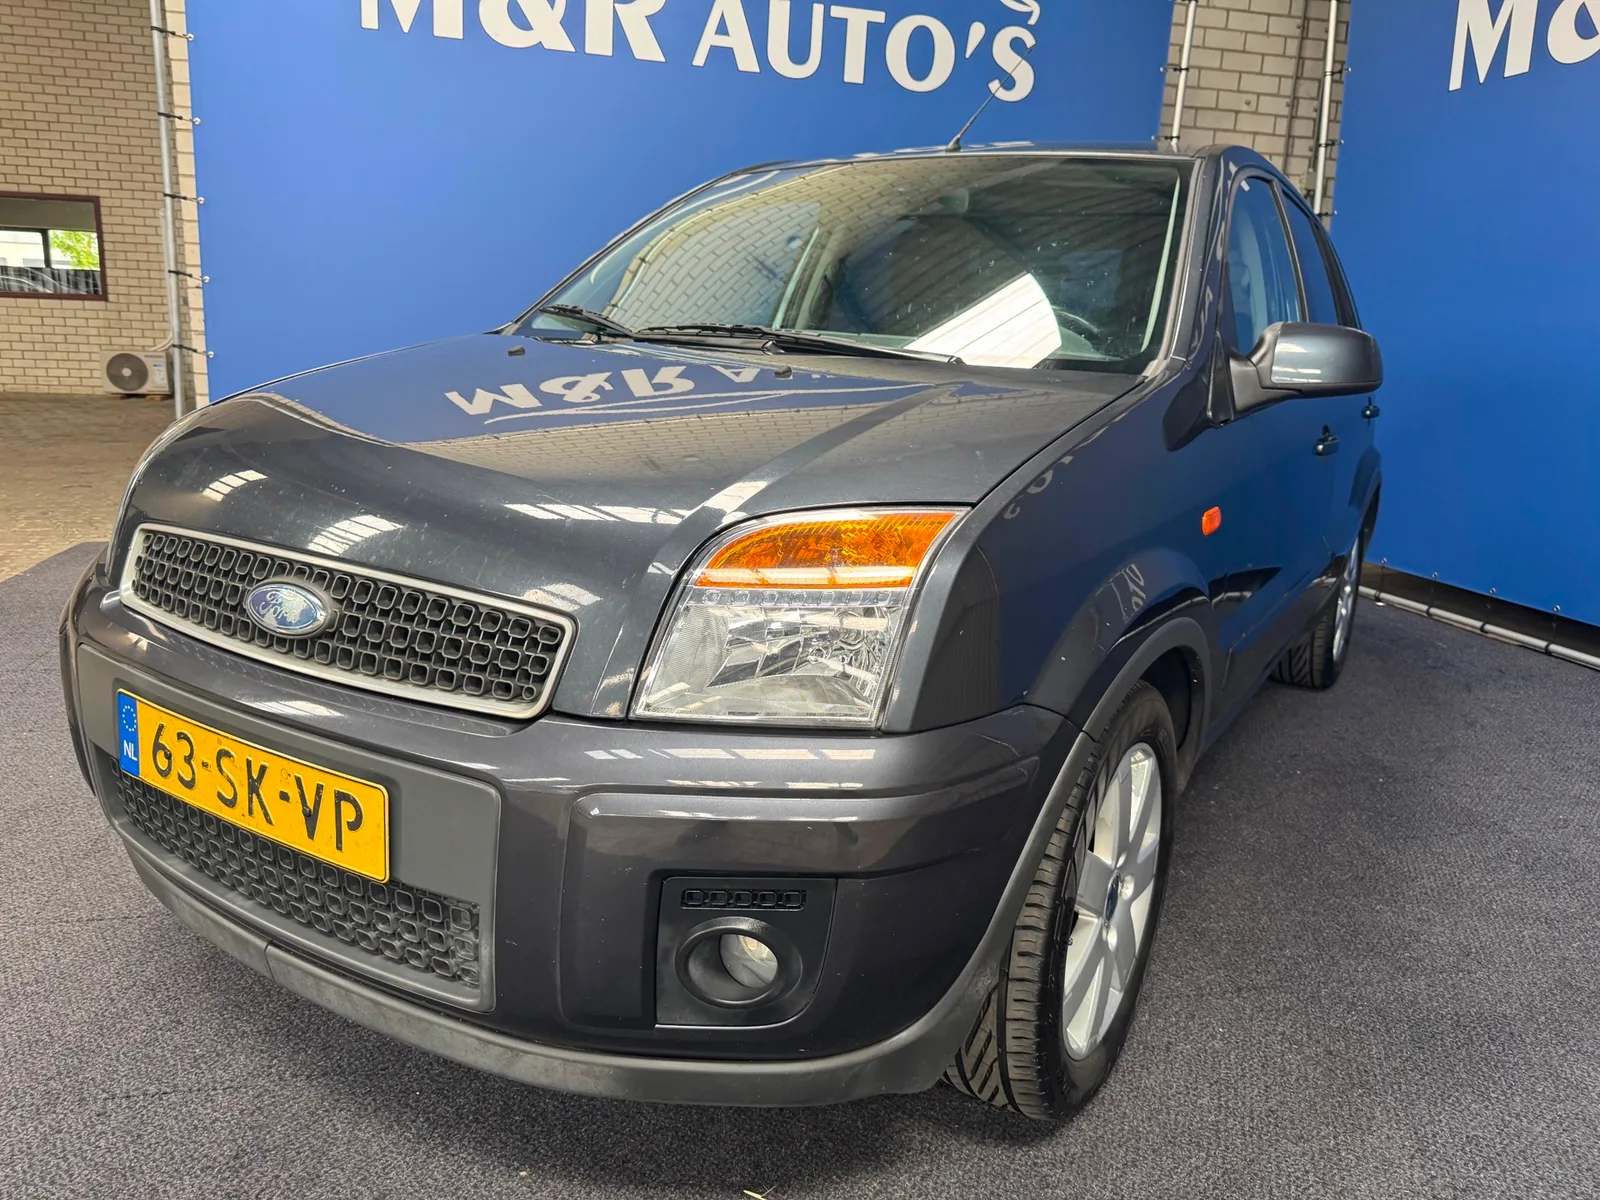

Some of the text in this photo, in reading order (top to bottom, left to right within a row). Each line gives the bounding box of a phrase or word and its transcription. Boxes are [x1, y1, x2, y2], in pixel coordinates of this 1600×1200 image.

[691, 0, 1036, 103] AUTO'S
[123, 739, 138, 762] NL
[152, 722, 364, 852] 63-SK-VP
